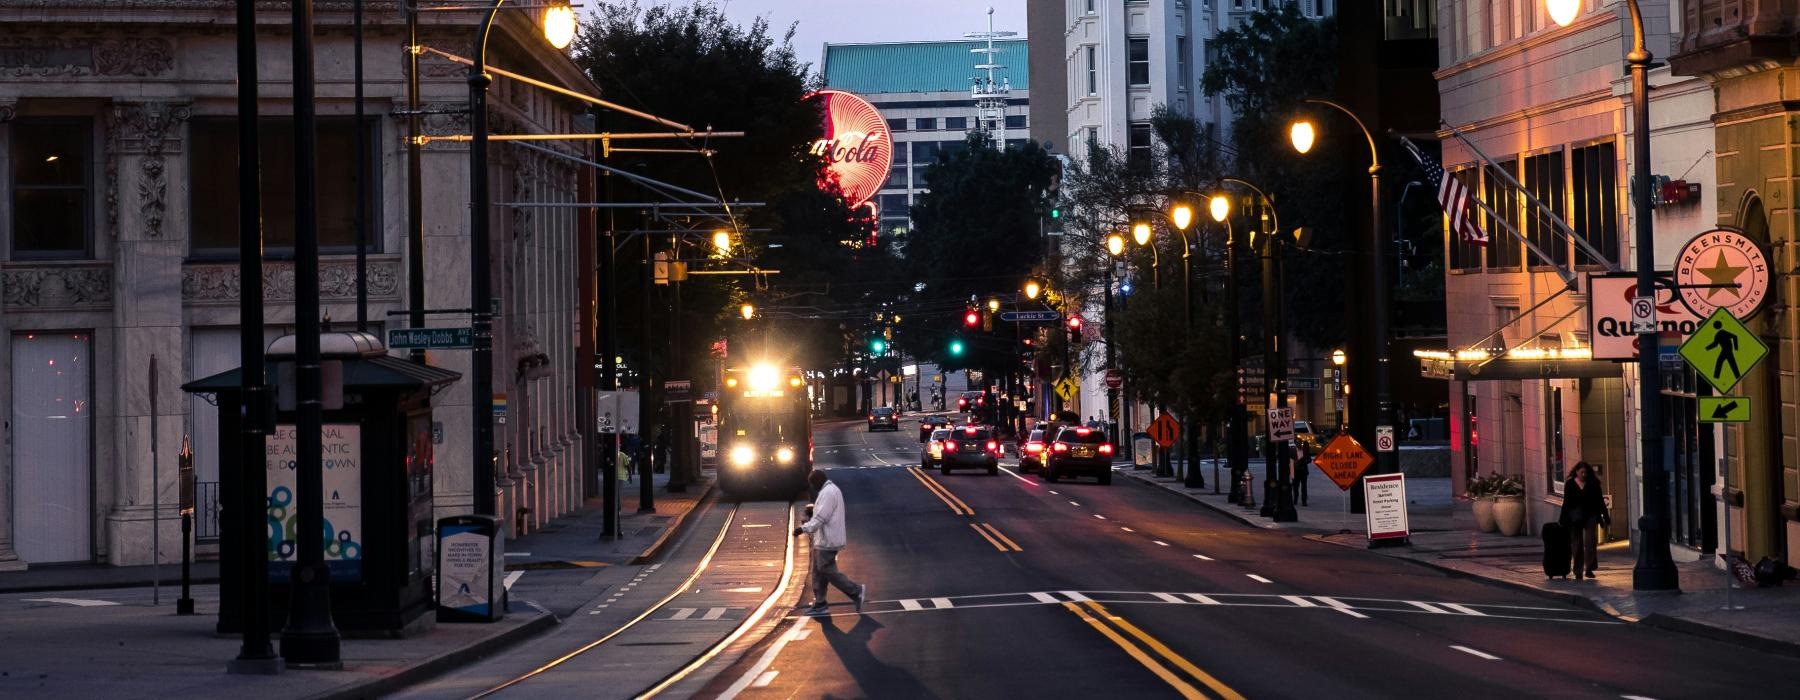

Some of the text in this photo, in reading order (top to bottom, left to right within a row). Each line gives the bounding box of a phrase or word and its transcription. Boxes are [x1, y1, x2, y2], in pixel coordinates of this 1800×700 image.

[1682, 235, 1764, 275] BREENSMITH
[1686, 290, 1760, 316] ADVEISING
[1597, 316, 1704, 337] Quno
[390, 331, 408, 345] John
[409, 331, 430, 347] Wesley
[432, 330, 453, 344] Dobbs
[1271, 410, 1290, 419] ONE
[1271, 420, 1291, 430] WAY
[267, 445, 280, 455] BE
[1323, 451, 1363, 460] RIGHT LANE
[1330, 461, 1358, 470] CLOSED
[1334, 471, 1356, 480] AHEAD
